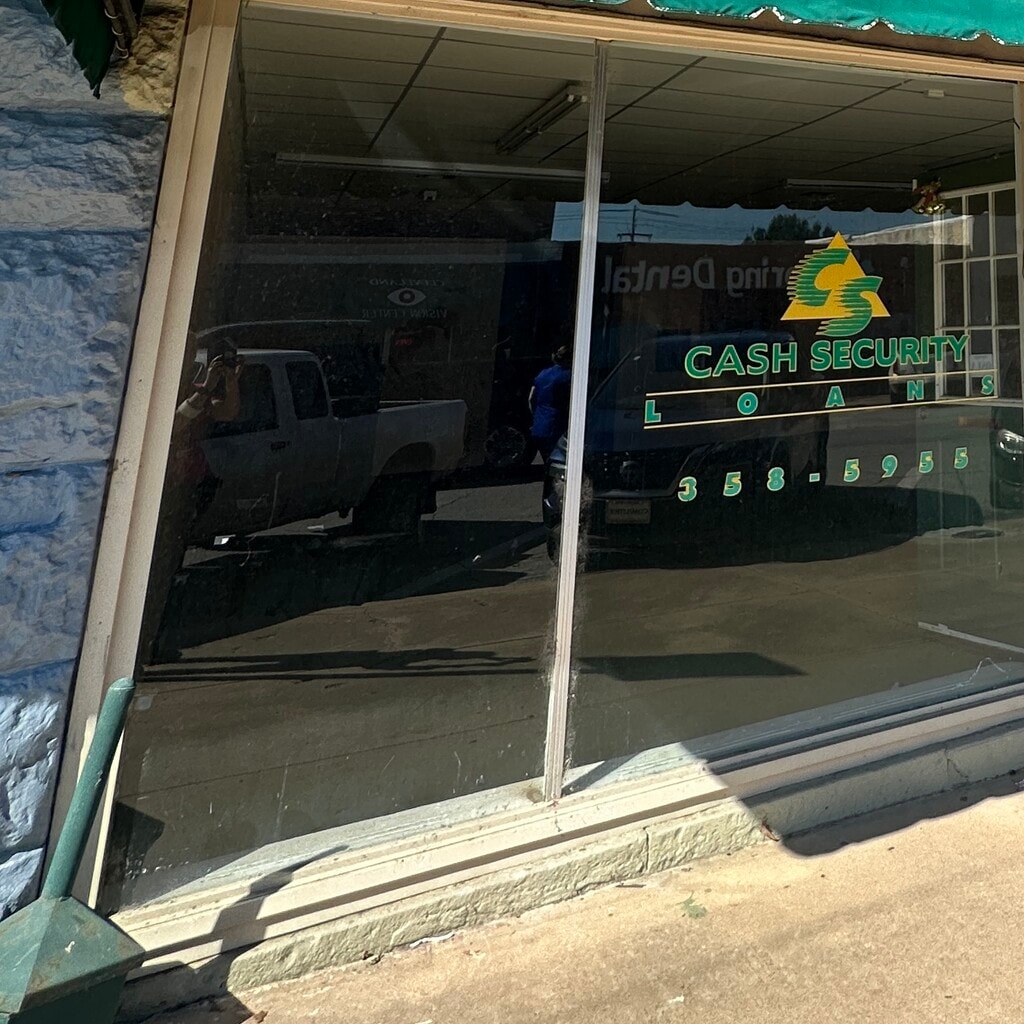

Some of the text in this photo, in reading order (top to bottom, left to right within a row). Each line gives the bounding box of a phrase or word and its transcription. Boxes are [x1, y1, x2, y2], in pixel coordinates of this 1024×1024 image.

[685, 334, 970, 379] CASH SECURITY
[644, 374, 995, 424] LOANS
[677, 446, 970, 503] 358-5955
